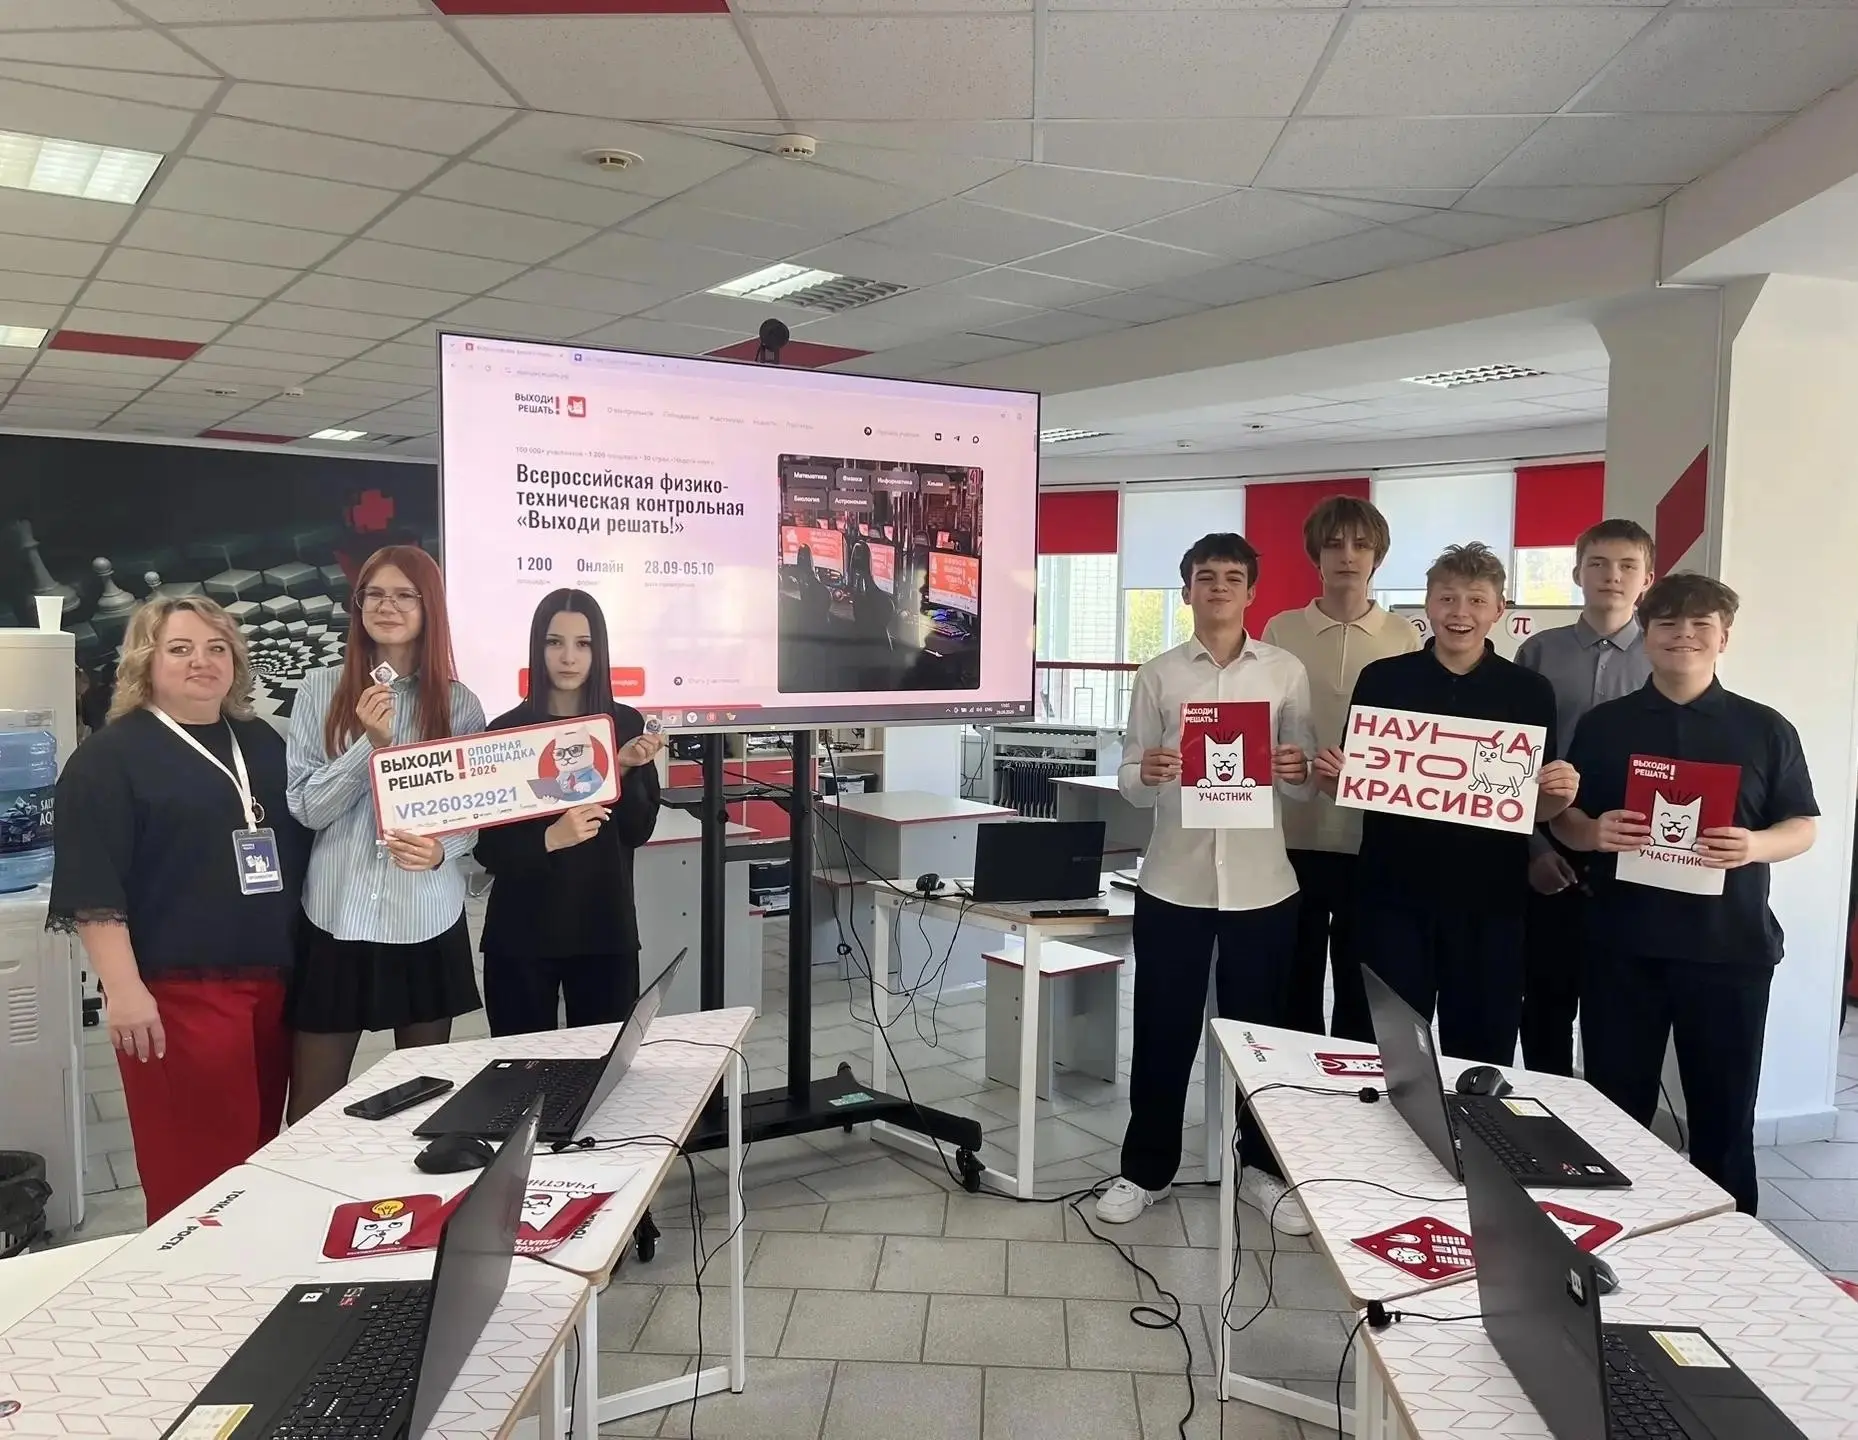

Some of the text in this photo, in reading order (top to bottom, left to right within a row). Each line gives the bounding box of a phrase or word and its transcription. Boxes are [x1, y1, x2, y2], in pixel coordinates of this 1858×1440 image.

[515, 393, 553, 404] ВЫХОДИ
[518, 404, 554, 415] РЕШАТЬ
[516, 463, 729, 494] Всероссийская физико-
[794, 472, 827, 480] Математика
[877, 476, 912, 485] Информатика
[517, 491, 744, 517] техническая контрольная
[793, 495, 868, 505] Биология Астрономия
[517, 510, 684, 535] «Выходи решать!»
[517, 556, 552, 571] 1 200
[577, 558, 624, 573] Онлайн
[644, 561, 714, 576] 28.09-05.10
[1353, 712, 1533, 756] НАУКА
[467, 740, 522, 757] ОПОРНАЯ
[380, 750, 453, 773] ВЫХОДИ
[468, 748, 536, 767] ПЛОЩАДКА
[1633, 759, 1670, 771] ВЫХОДИ
[470, 765, 497, 777] 2026
[1634, 768, 1668, 780] РЕШАТЬ
[389, 769, 455, 791] РЕШАТЬ
[395, 786, 518, 821] VR26032921
[1198, 792, 1253, 801] УЧАСТНИК
[1342, 776, 1524, 823] КРАСИВО
[1639, 849, 1702, 866] УЧАСТНИК
[527, 1179, 598, 1190] УЧАСТН
[156, 1189, 246, 1251] ТОЧКА РОСТА
